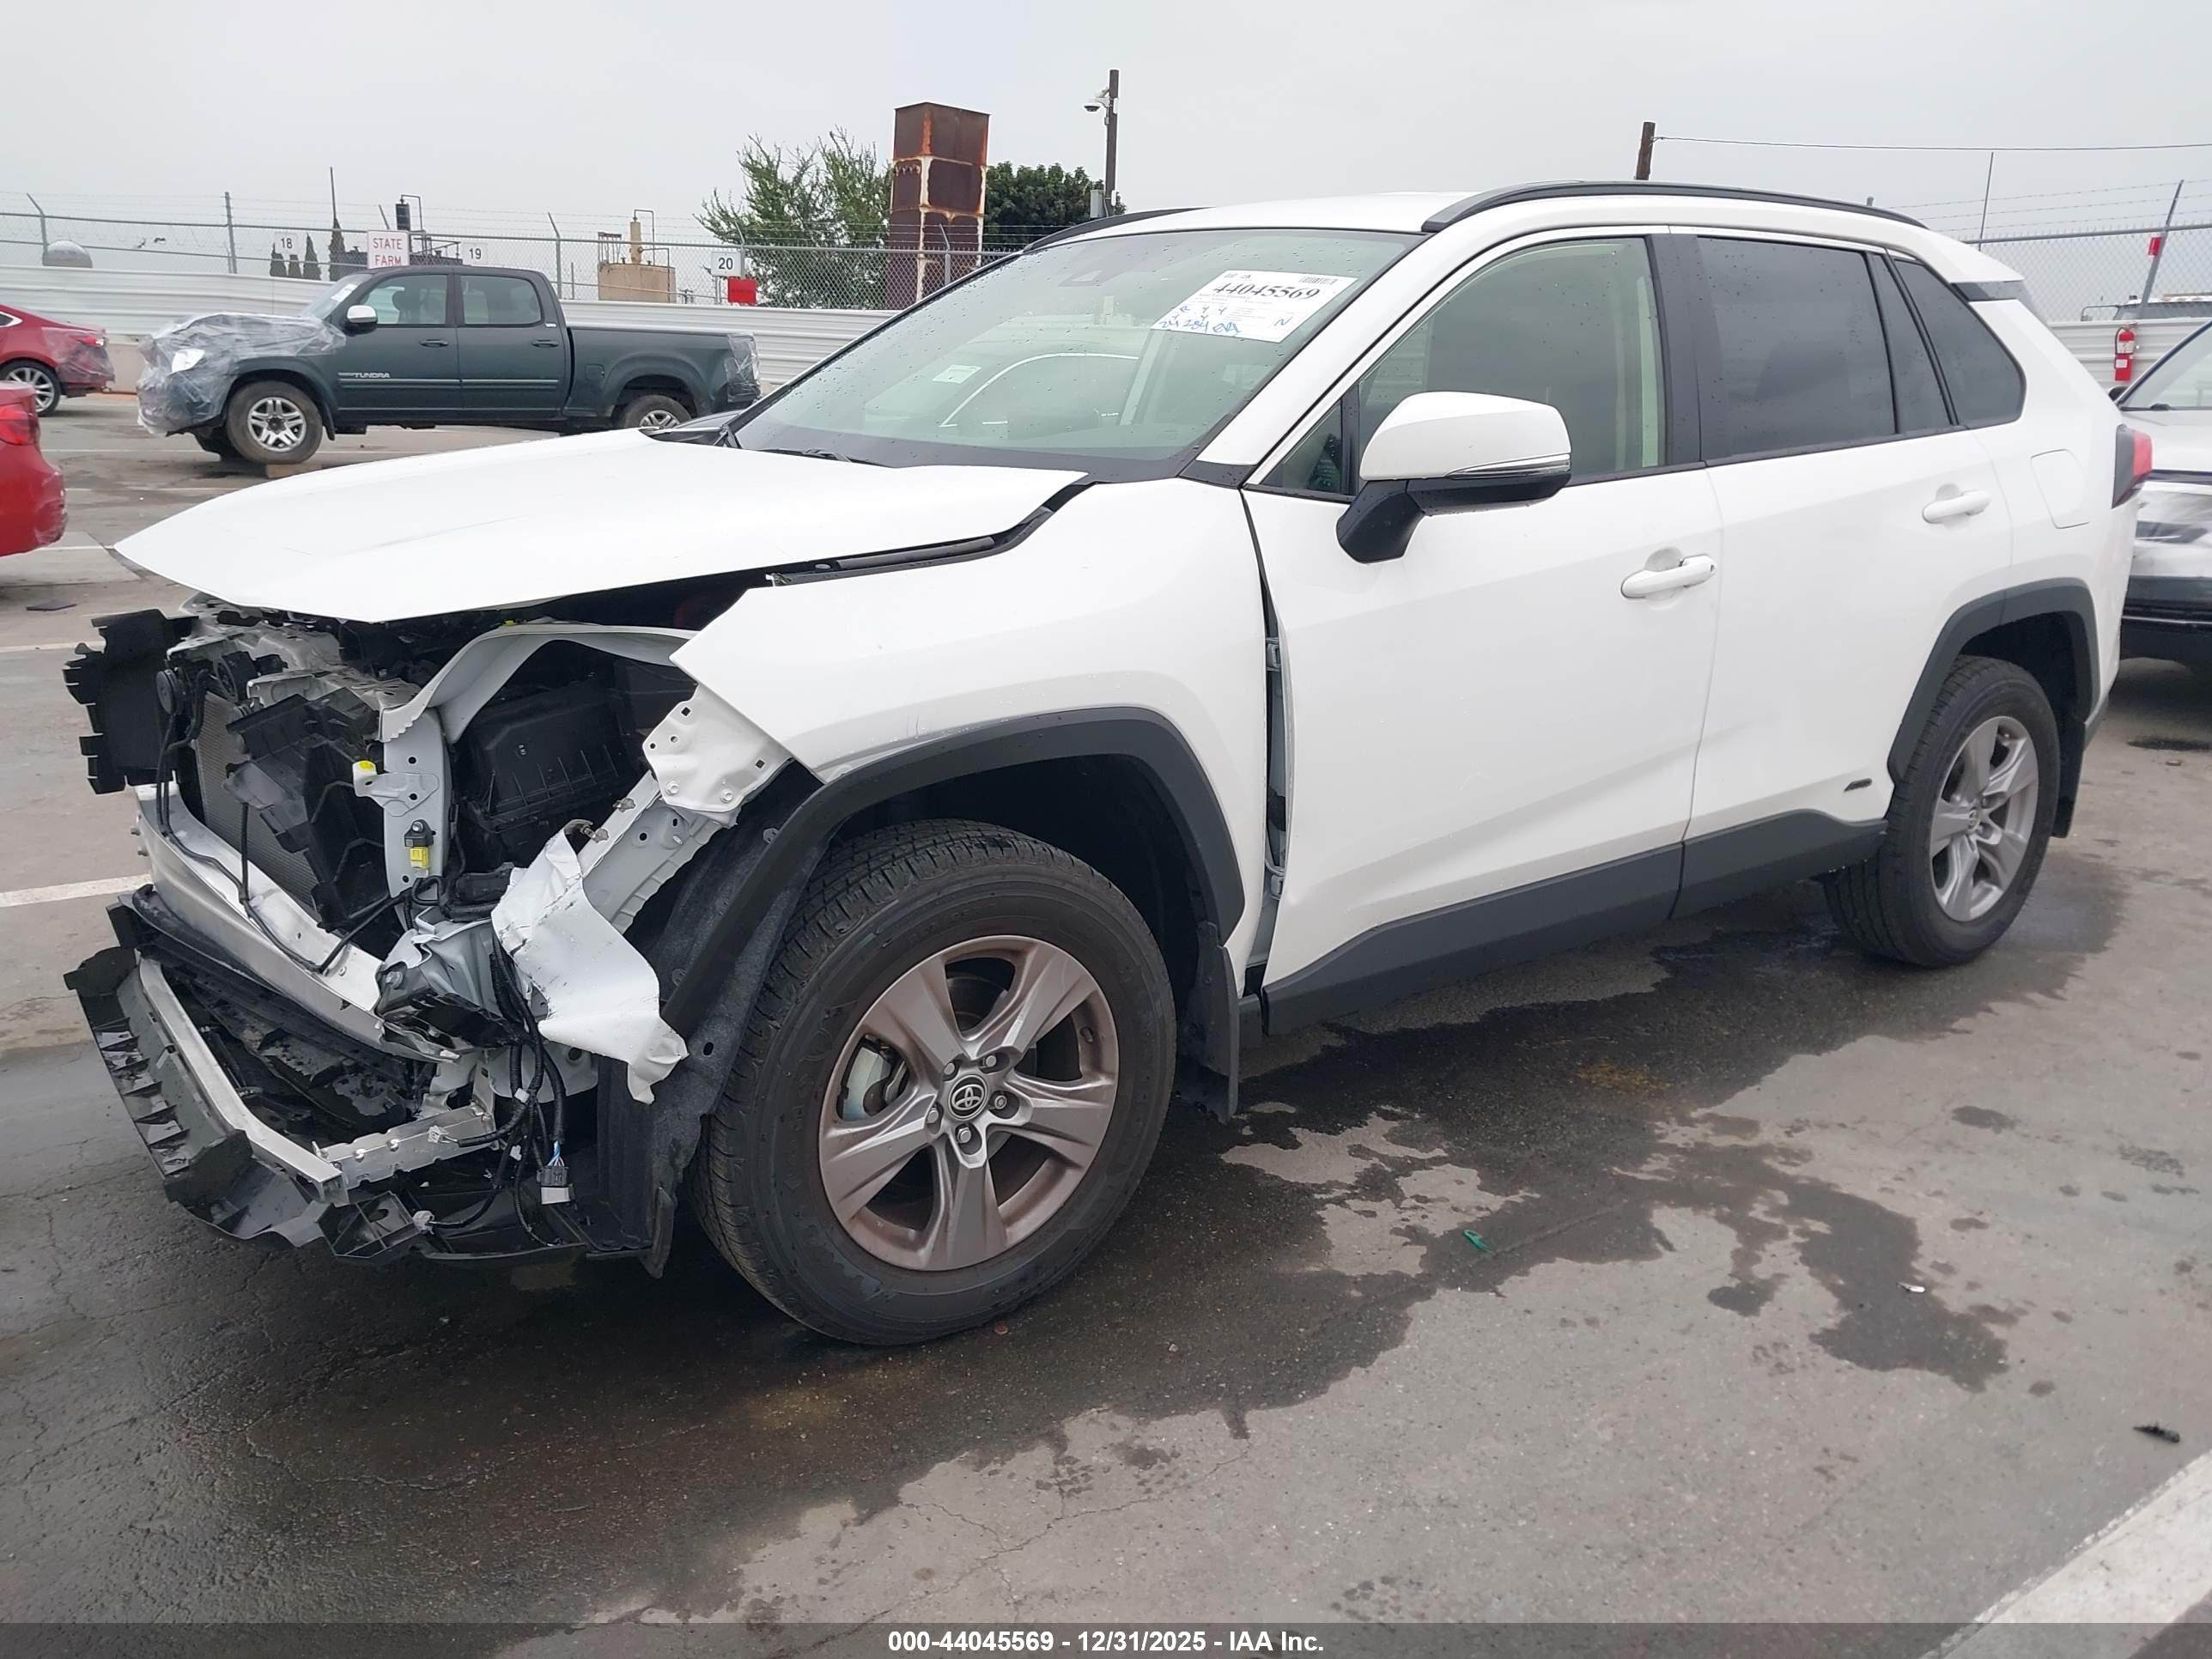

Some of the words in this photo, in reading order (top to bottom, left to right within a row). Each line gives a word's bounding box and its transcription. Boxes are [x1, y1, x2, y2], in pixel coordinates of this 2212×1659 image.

[281, 237, 293, 249] 18
[372, 237, 403, 249] STATE
[469, 247, 482, 259] 19
[374, 254, 402, 266] FARM
[718, 257, 733, 270] 20
[1212, 282, 1322, 300] 44045569
